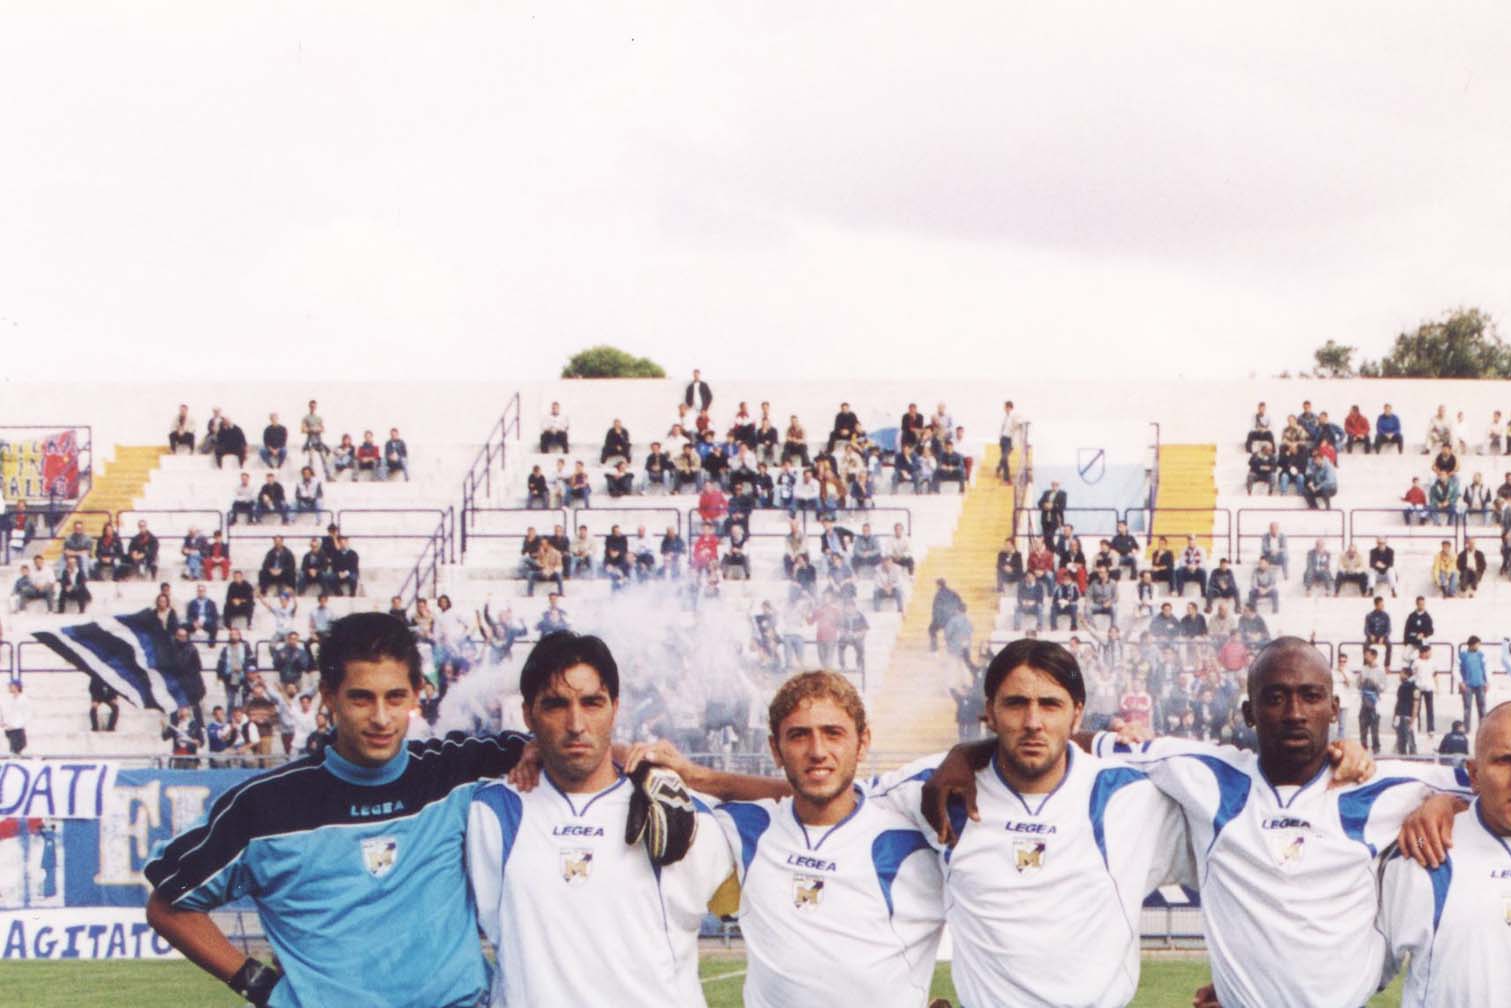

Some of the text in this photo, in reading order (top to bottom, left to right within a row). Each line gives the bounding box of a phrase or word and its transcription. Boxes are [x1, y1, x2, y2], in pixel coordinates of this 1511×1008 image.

[351, 800, 405, 817] LEGEA
[553, 825, 605, 838] LEGEA
[1005, 821, 1057, 836] LEGEA
[1262, 817, 1312, 831] LEGEA
[787, 854, 837, 872] LEGEA
